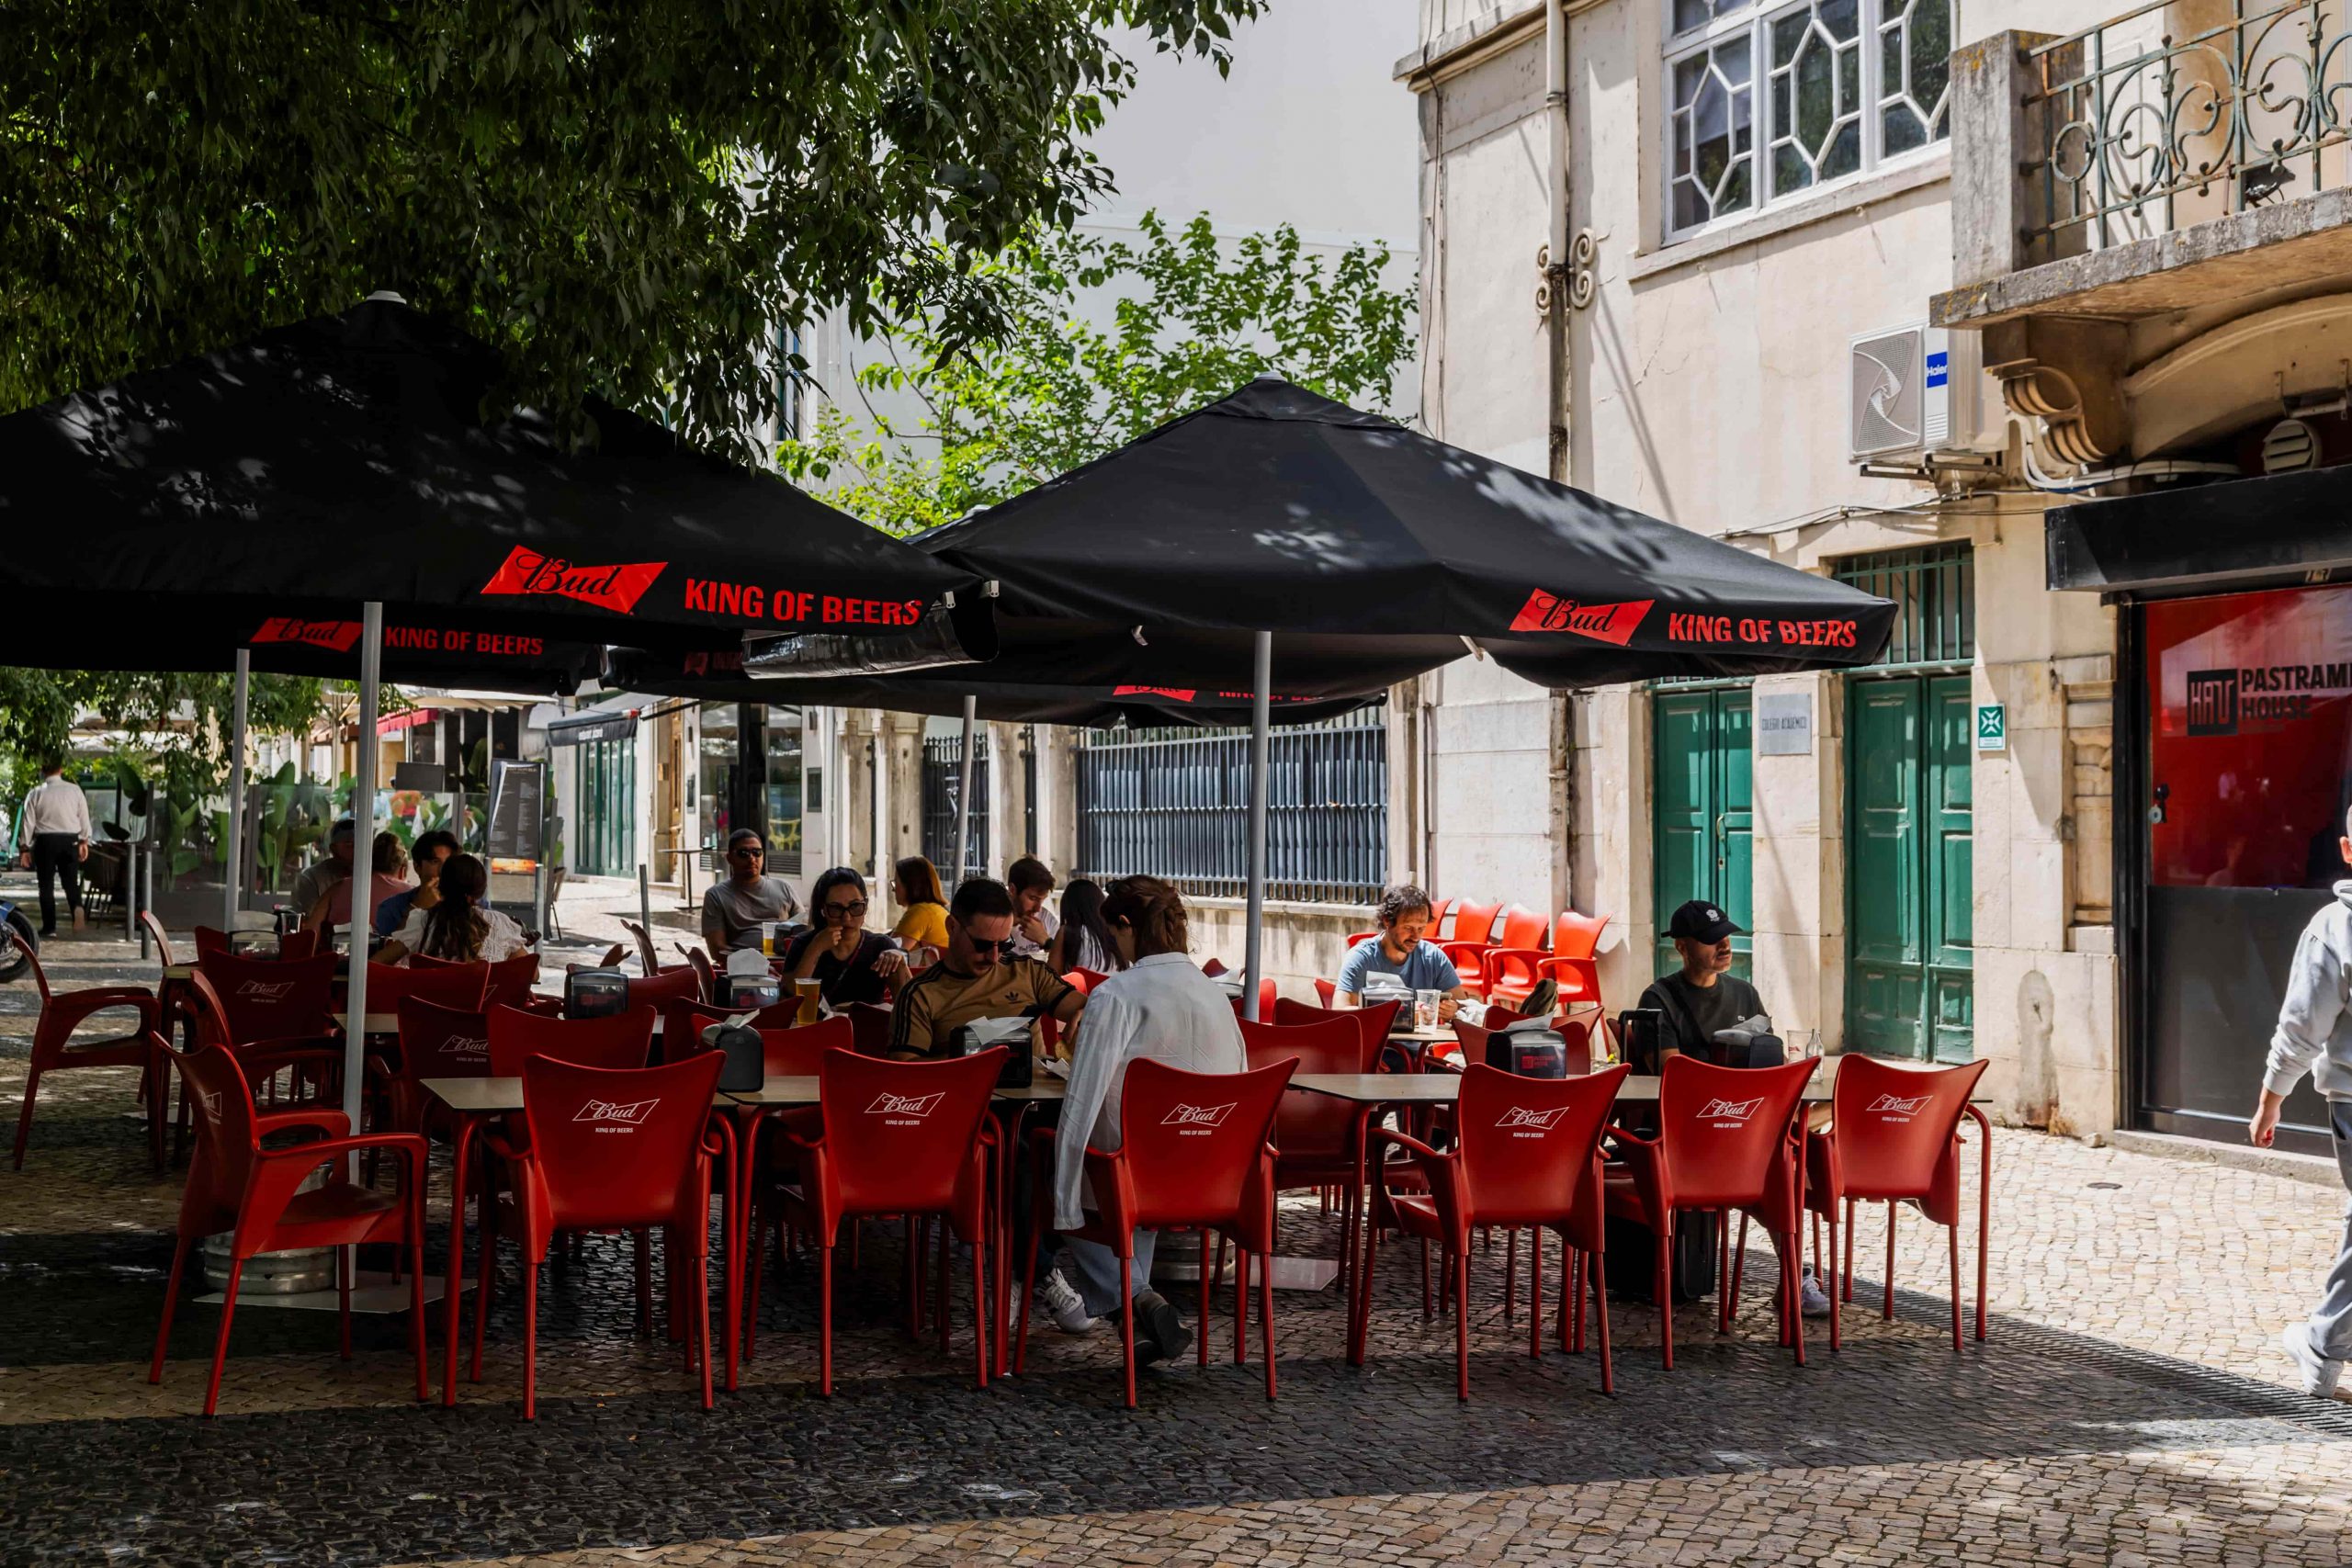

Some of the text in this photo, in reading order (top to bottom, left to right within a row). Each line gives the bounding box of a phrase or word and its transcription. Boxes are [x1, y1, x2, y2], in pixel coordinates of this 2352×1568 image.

[1927, 365, 1948, 377] Haier
[515, 554, 922, 626] Bud KING OF BEERS
[1535, 596, 1857, 648] Bud KING OF BEERS
[276, 617, 543, 656] Bud KING OF BEERS
[2242, 663, 2352, 692] PASTRAM
[2242, 694, 2312, 720] HOUSE
[452, 1037, 488, 1051] Bud
[591, 1102, 636, 1119] Bud
[882, 1096, 923, 1111] Bud
[1712, 1101, 1749, 1115] Bud
[1882, 1097, 1917, 1111] Bud
[1178, 1106, 1219, 1122] Bud
[1512, 1110, 1550, 1123] Bud
